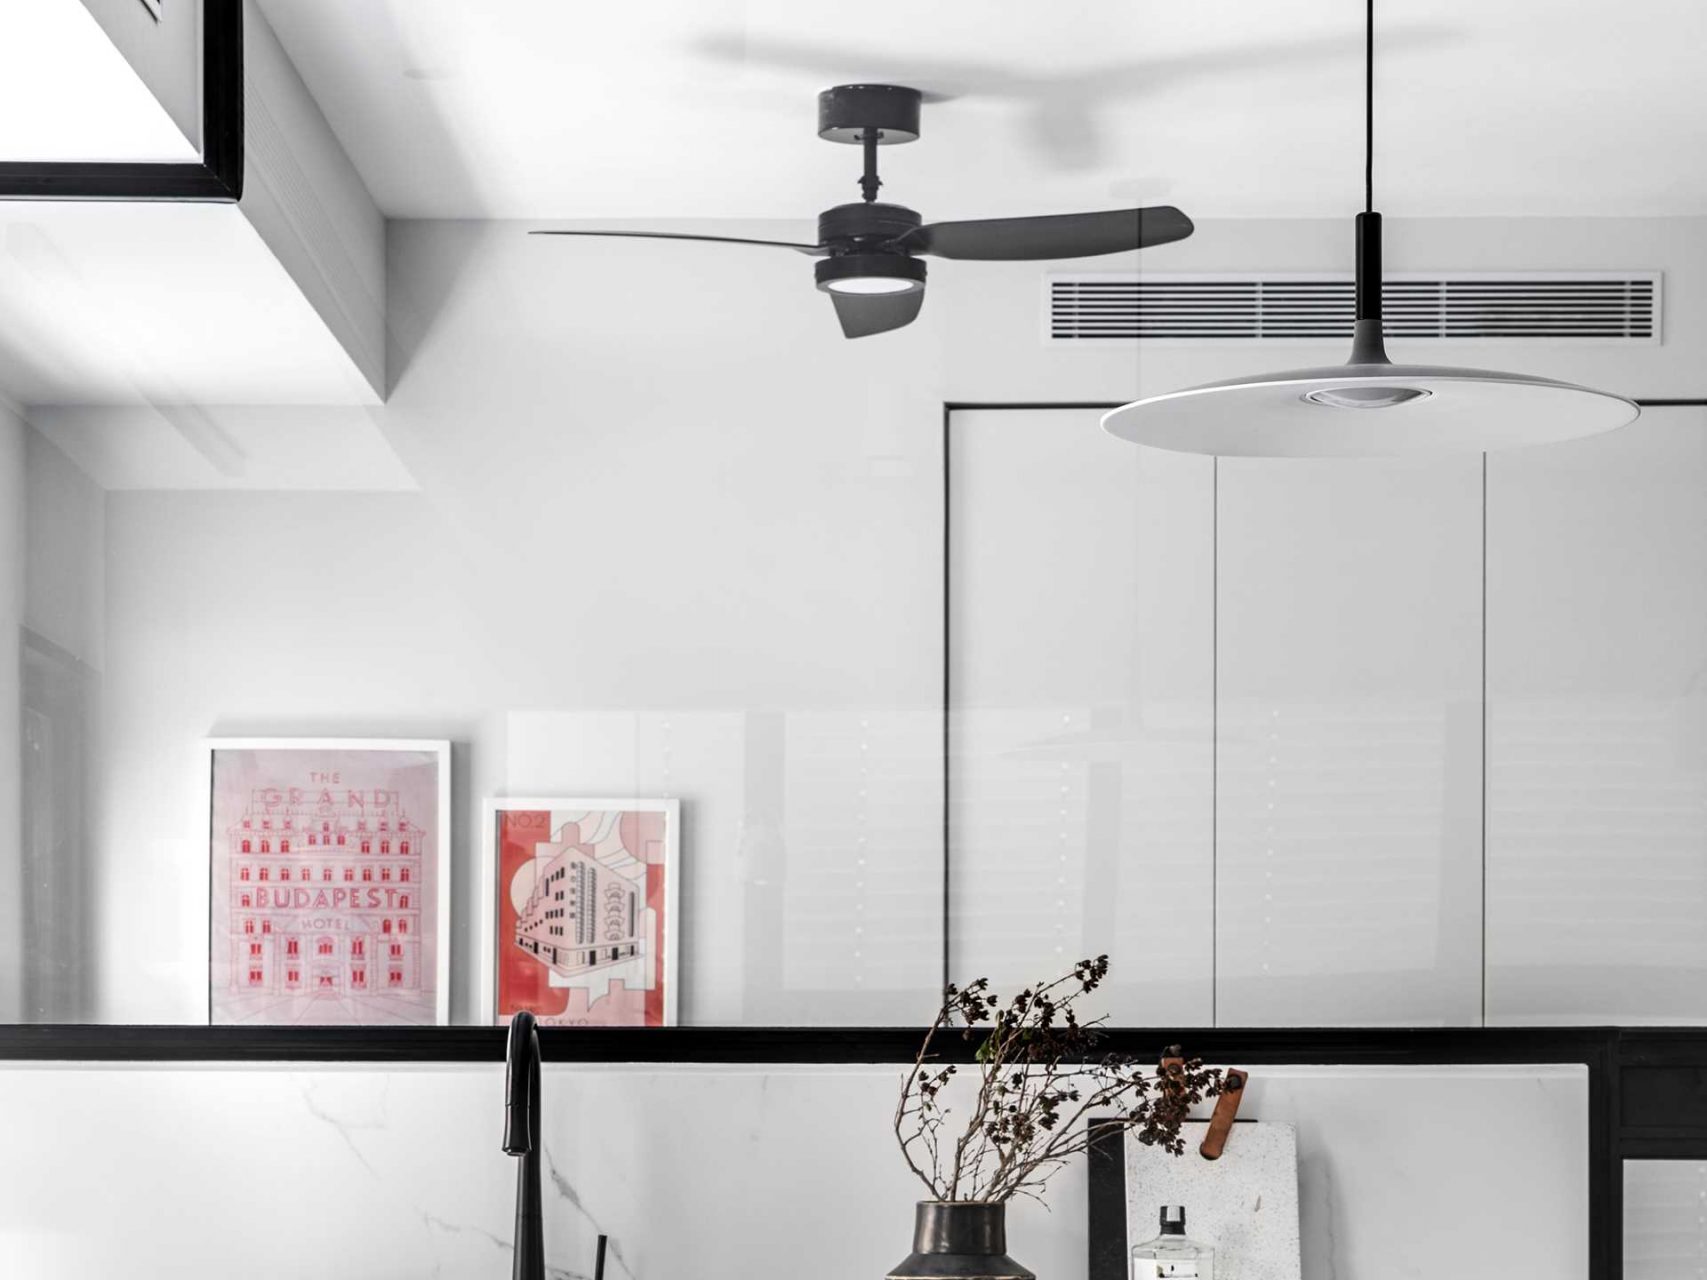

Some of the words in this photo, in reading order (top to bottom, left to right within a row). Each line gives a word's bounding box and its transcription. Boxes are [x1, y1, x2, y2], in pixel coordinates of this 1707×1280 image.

[310, 772, 341, 784] THE
[262, 787, 391, 808] GRAND
[256, 888, 398, 909] BUDAPEST
[302, 919, 350, 930] HOTEL
